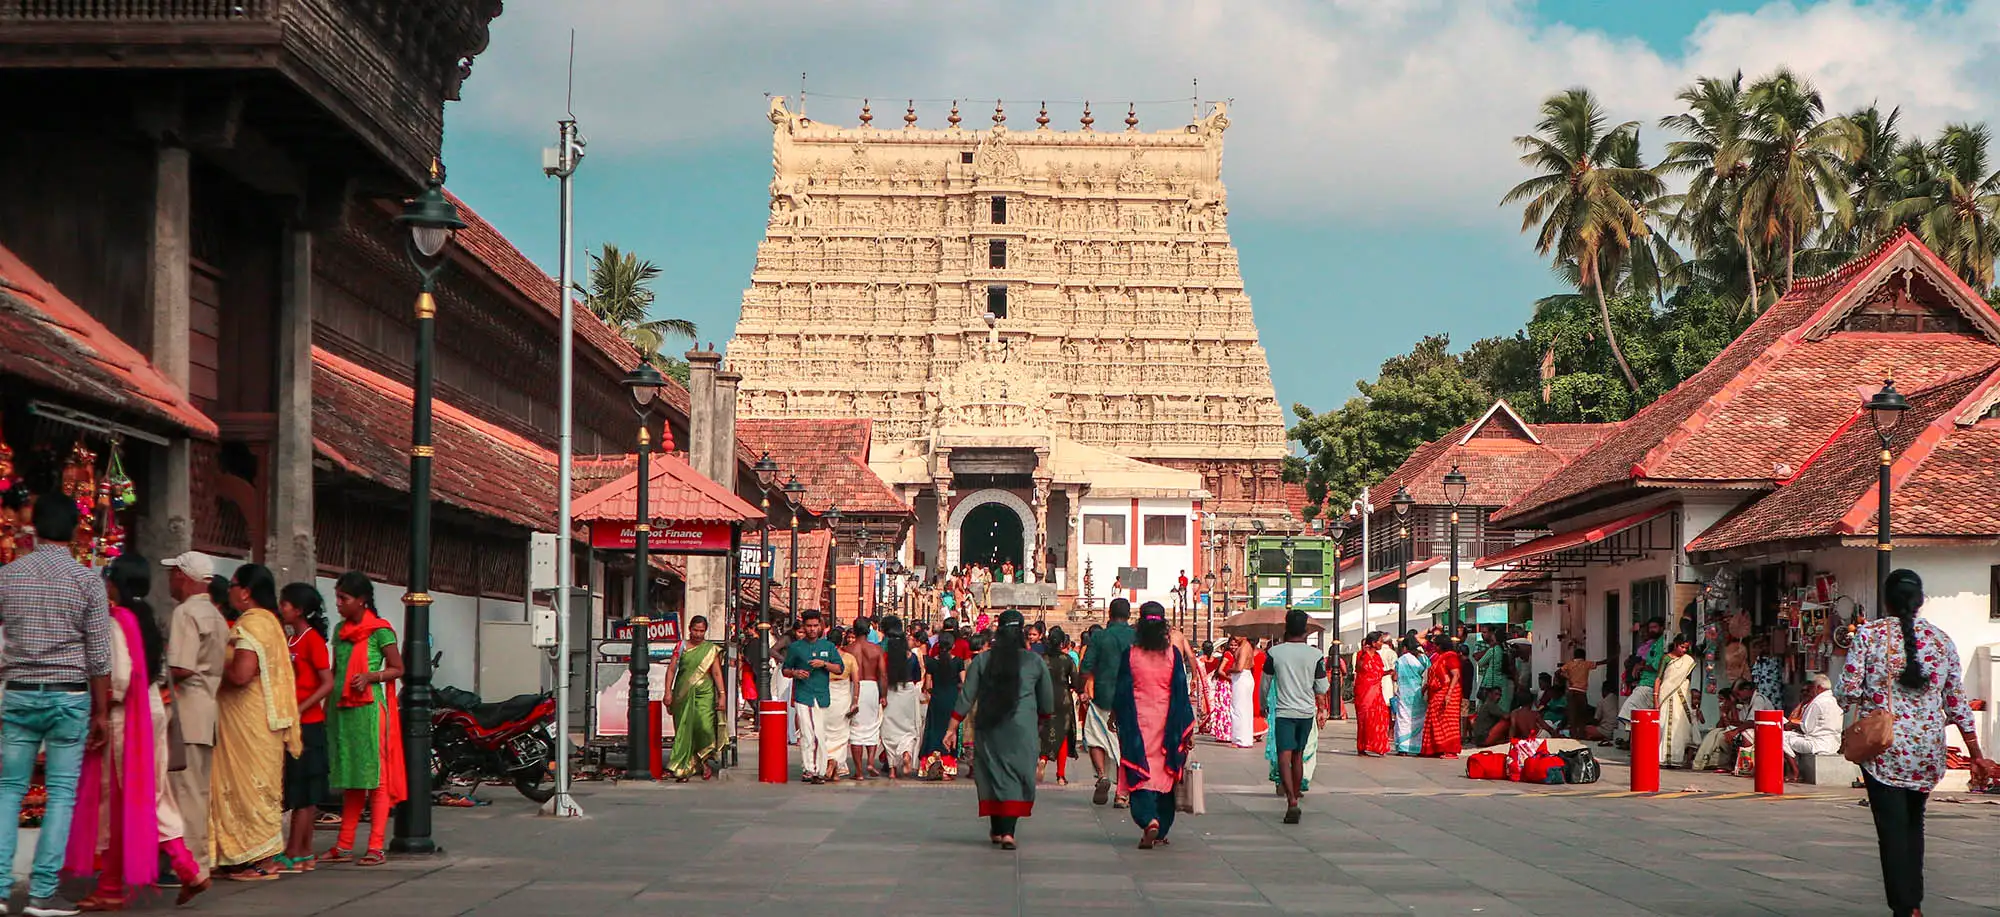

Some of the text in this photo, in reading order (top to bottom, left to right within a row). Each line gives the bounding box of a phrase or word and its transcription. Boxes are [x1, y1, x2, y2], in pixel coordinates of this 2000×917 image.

[620, 529, 703, 538] Muoot Finance
[619, 622, 675, 639] BAOOM
